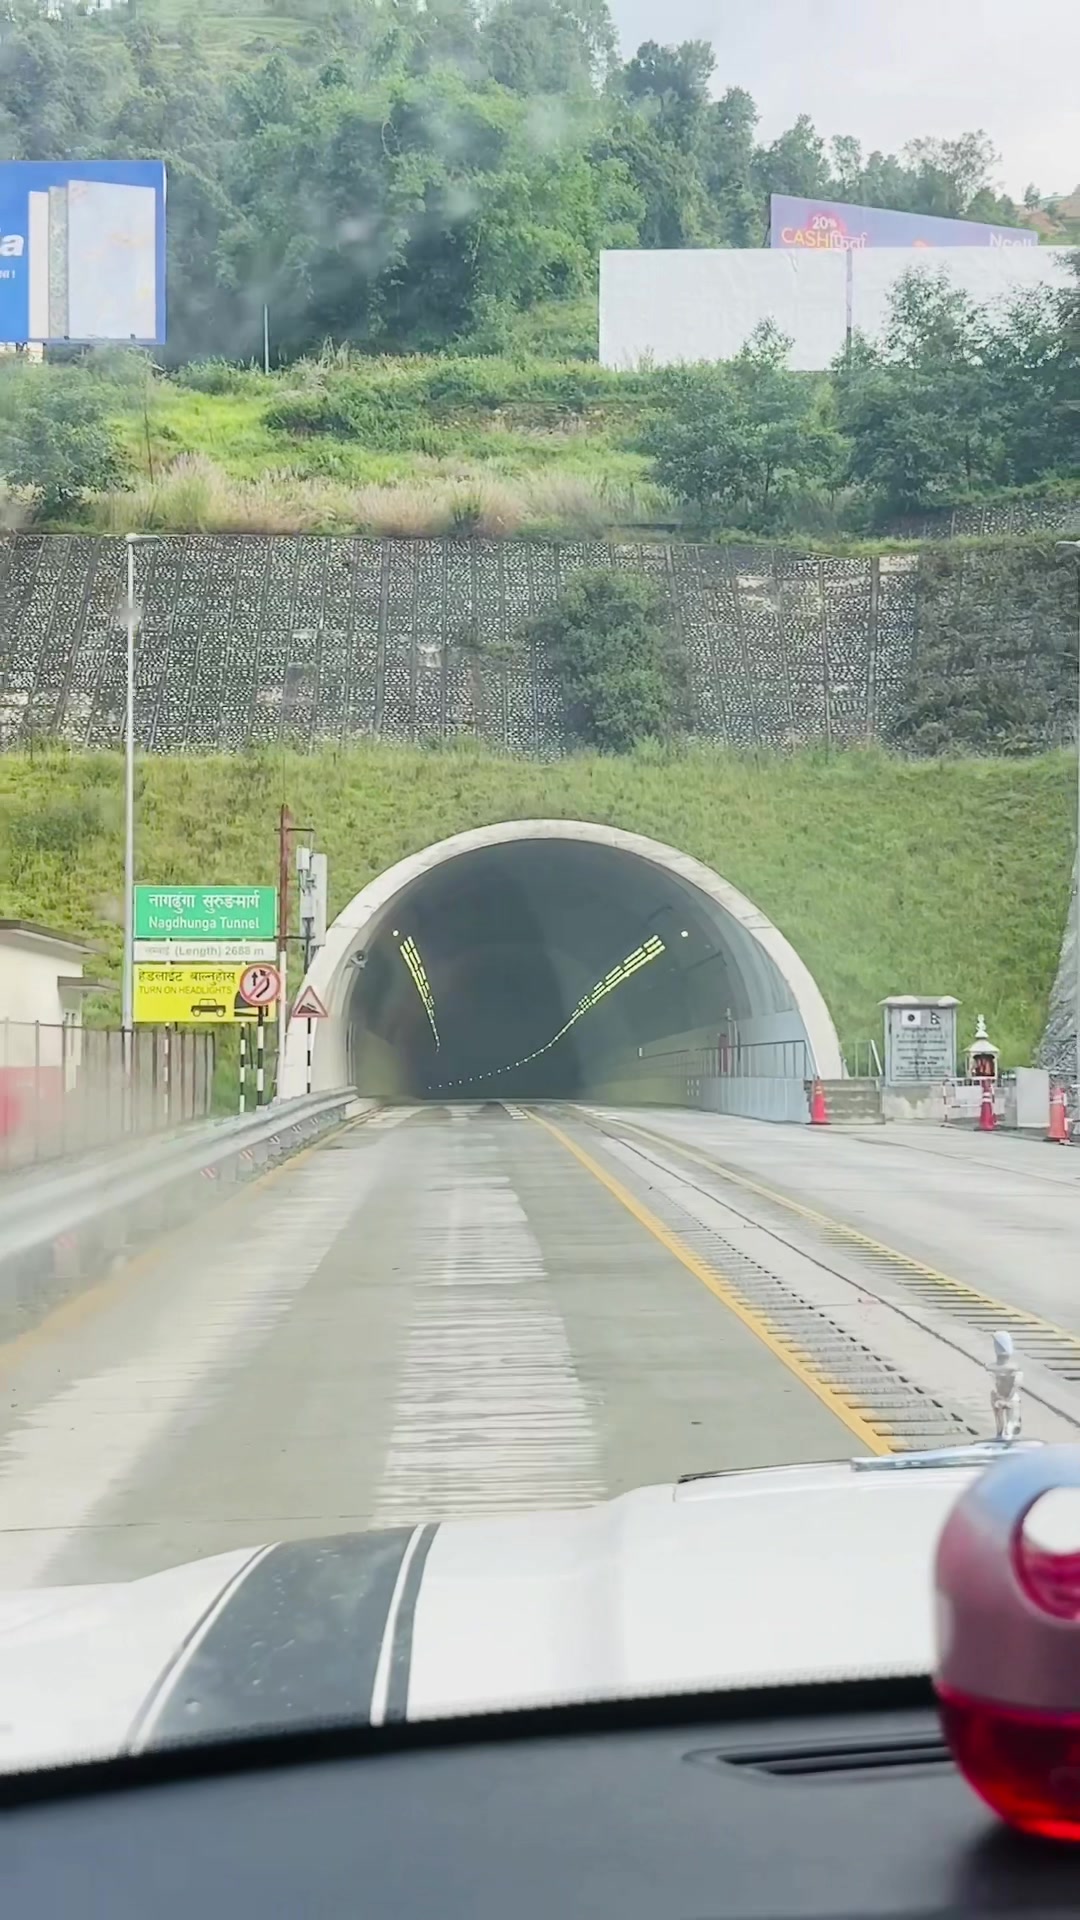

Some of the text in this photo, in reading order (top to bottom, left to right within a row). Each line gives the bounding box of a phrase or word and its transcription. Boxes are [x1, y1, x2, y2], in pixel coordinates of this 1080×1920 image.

[811, 215, 837, 230] 20%
[148, 891, 196, 914] नागढुंगा
[149, 916, 260, 931] Nagdhunga Tunnel
[175, 945, 222, 957] (Length)
[254, 948, 264, 956] m
[139, 985, 233, 995] TURN ON HEADLIGHTS
